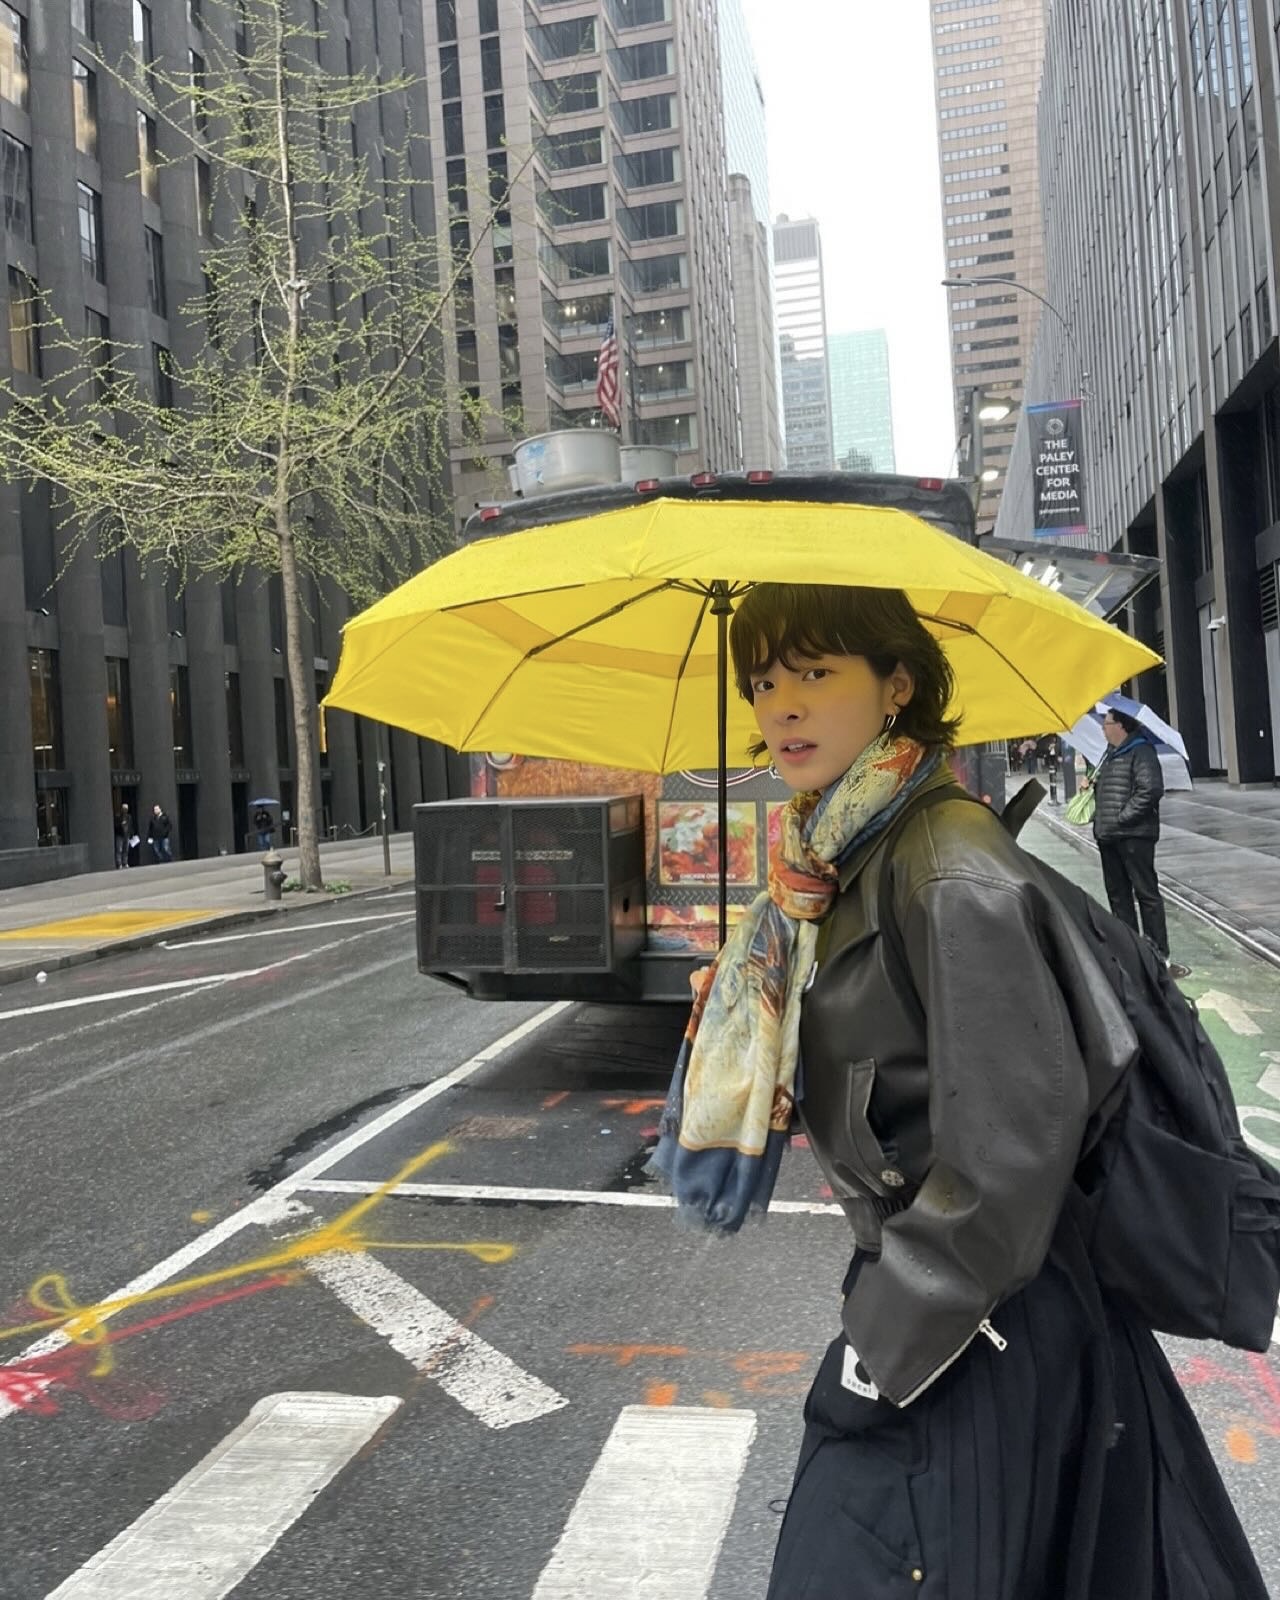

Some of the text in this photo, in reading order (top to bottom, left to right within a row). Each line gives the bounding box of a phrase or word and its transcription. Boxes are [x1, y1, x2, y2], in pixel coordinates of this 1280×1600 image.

[1044, 439, 1068, 449] THE
[1039, 451, 1075, 463] PALEY
[1036, 463, 1080, 476] CENTER
[1046, 477, 1071, 488] FOR
[1040, 489, 1078, 501] MEDIA
